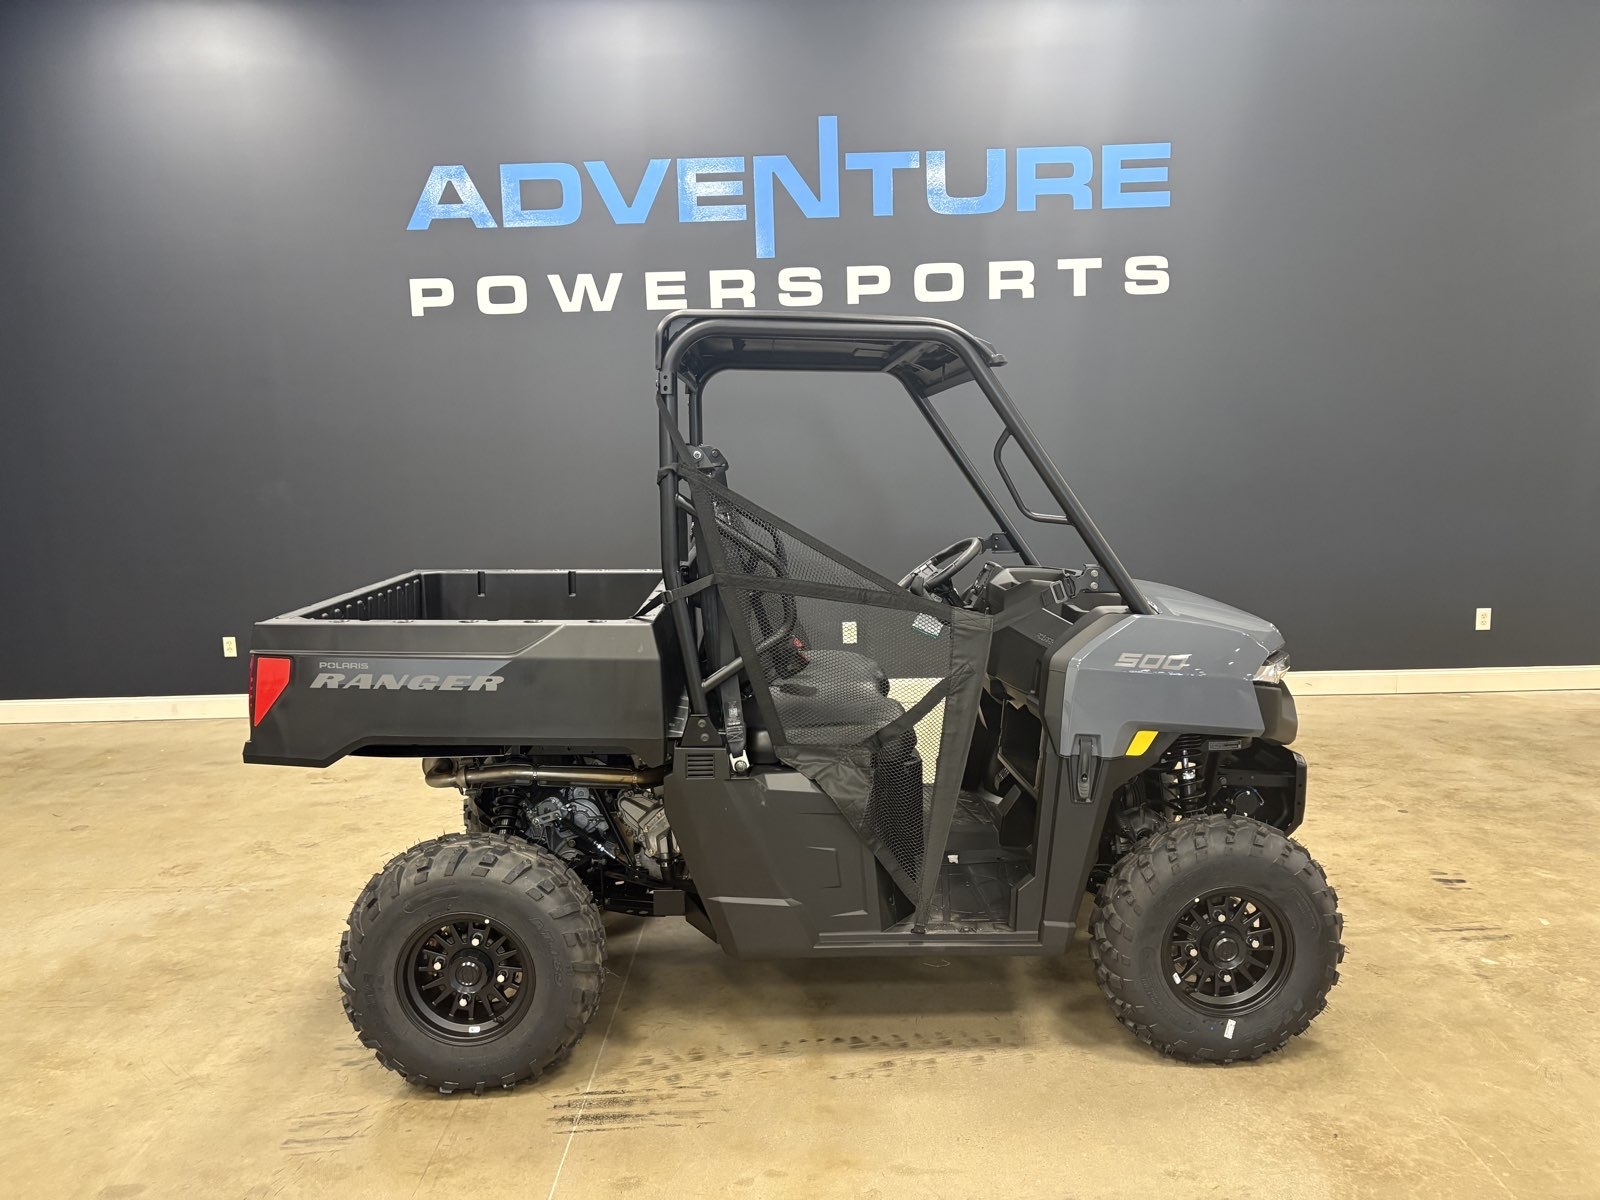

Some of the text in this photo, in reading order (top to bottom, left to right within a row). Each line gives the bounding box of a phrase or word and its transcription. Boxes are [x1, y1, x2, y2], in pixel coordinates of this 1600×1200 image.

[407, 115, 1172, 259] ADVENTURE
[409, 255, 1171, 317] POWERSPORTS
[319, 661, 369, 670] POLARIS
[1113, 652, 1192, 670] 500
[309, 673, 505, 692] RANGER
